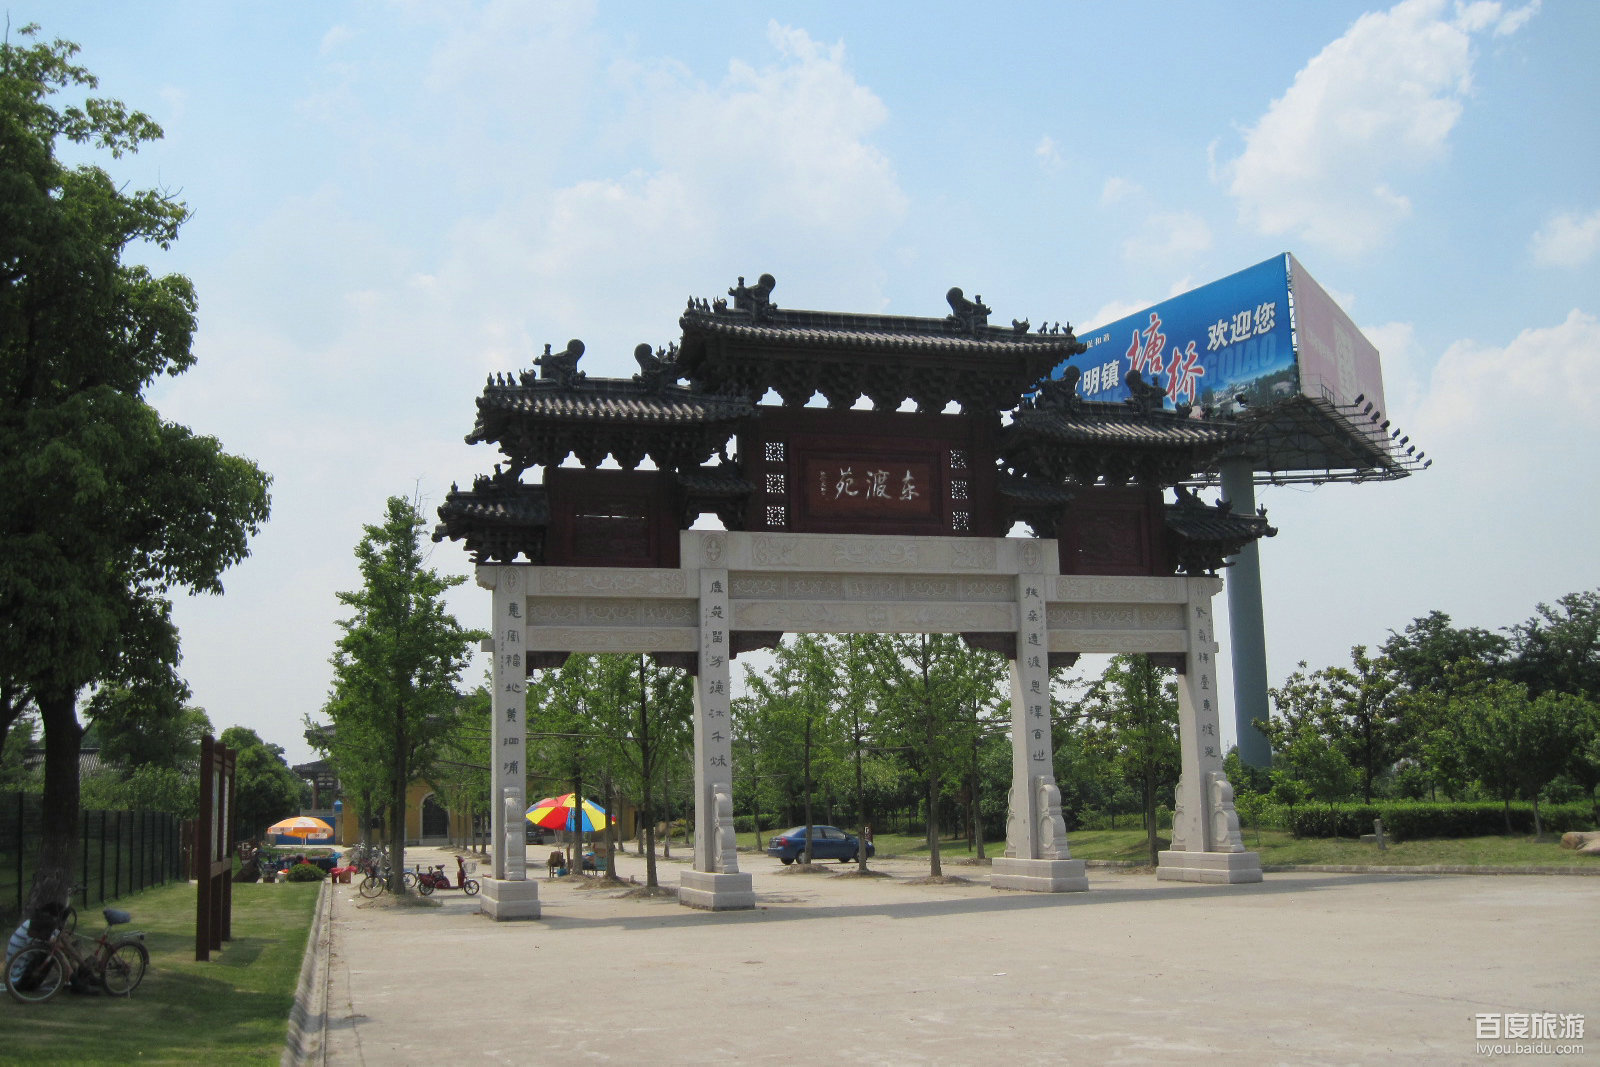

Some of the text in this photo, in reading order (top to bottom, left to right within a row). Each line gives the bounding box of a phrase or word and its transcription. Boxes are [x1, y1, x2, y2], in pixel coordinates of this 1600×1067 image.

[1075, 360, 1120, 397] 明镇
[1126, 312, 1205, 404] 塘桥
[1206, 301, 1276, 351] 欢迎您
